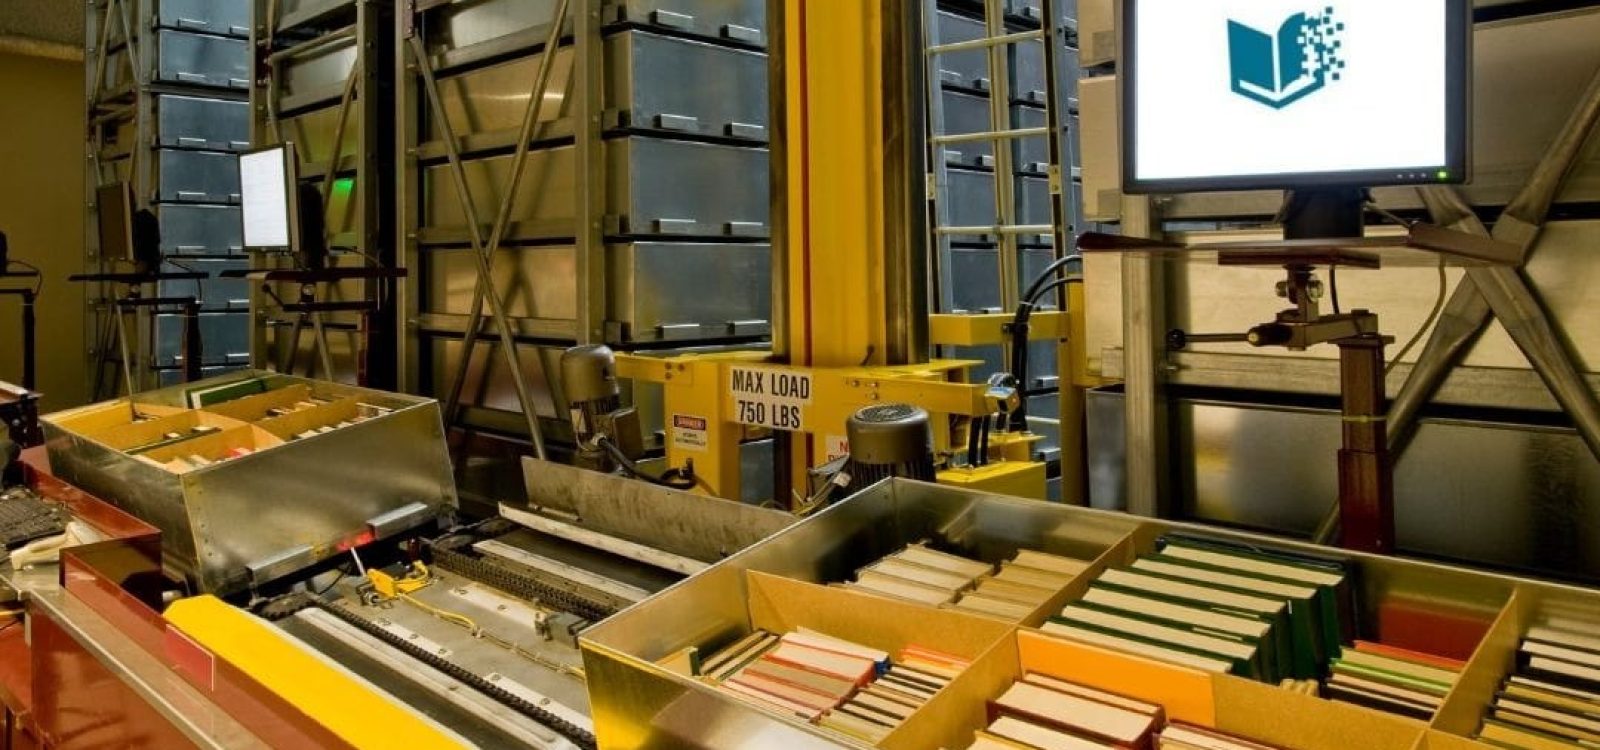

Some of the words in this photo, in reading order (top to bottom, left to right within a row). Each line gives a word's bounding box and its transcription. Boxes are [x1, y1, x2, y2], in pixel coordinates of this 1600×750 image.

[732, 369, 764, 394] MAX
[771, 373, 810, 399] LOAD
[738, 400, 766, 424] 750
[772, 404, 801, 429] LBS
